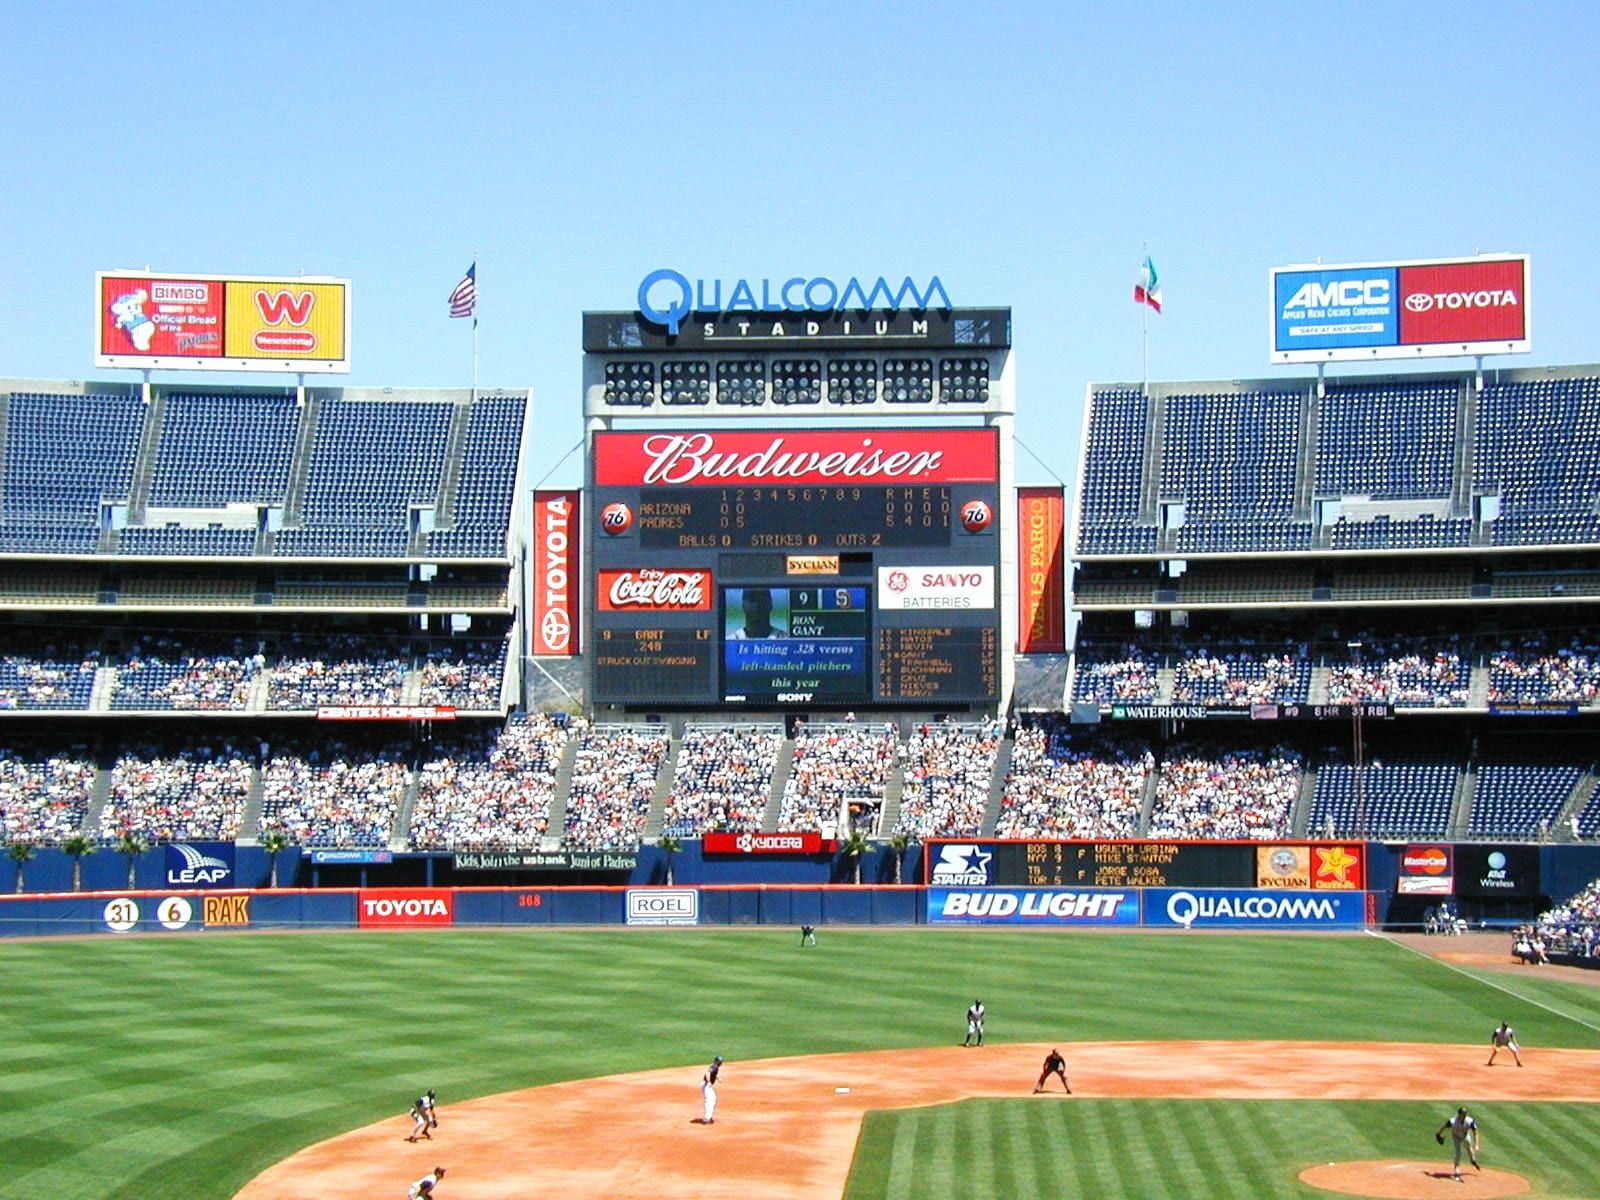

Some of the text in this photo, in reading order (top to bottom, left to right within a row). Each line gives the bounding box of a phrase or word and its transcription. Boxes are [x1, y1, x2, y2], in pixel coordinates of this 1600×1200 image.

[154, 287, 205, 300] BIMBO
[1284, 279, 1389, 309] AMCC
[1434, 289, 1517, 309] TOYOTA
[637, 268, 953, 335] QUALCOMM
[151, 313, 217, 325] Official Bread
[703, 319, 929, 337] STADIUM
[642, 432, 943, 485] Budweiser
[721, 490, 727, 501] 1
[736, 490, 745, 501] 2
[753, 490, 762, 501] 3
[770, 490, 778, 501] 4
[787, 490, 796, 501] 5
[803, 489, 812, 500] 6
[836, 489, 845, 500] 8
[852, 489, 861, 500] 9
[886, 488, 895, 499] R
[905, 488, 913, 499] H
[923, 488, 931, 499] E
[639, 501, 950, 515] ARIZONA 0 0 0 0 0 0
[605, 511, 625, 525] 76
[639, 517, 685, 529] PADRES
[720, 517, 729, 528] 0
[736, 517, 745, 528] 5
[886, 515, 895, 526] 5
[905, 515, 913, 526] 4
[923, 515, 931, 526] 0
[966, 509, 984, 523] 76
[679, 534, 881, 547] BALLS 0 STRIKES 0 OUTS 2
[1030, 501, 1045, 568] FARGO
[546, 495, 568, 606] TOYOTA
[789, 560, 837, 569] SYCUAN
[639, 569, 665, 580] Enjoy
[921, 573, 983, 587] SANYO
[799, 592, 809, 605] 9
[903, 597, 971, 608] BATTERIES
[792, 616, 816, 625] RON
[603, 629, 712, 640] 9 GANT LF
[792, 626, 824, 636] GANT
[634, 641, 662, 652] .248
[738, 644, 748, 655] Is
[753, 644, 788, 656] hitting
[819, 645, 854, 655] versus
[597, 656, 630, 666] STRUCK
[632, 656, 650, 666] OUT
[741, 661, 852, 673] left-handed pitchers
[771, 677, 820, 690] this year
[776, 693, 814, 702] SONY
[1126, 706, 1207, 719] WATERHOUSE
[1284, 707, 1299, 717] #9
[1314, 706, 1322, 717] 8
[1323, 706, 1340, 716] HR
[1367, 706, 1388, 717] RBI
[752, 837, 802, 849] KYOCERA
[1027, 844, 1048, 854] BOS
[1139, 844, 1179, 854] URBINA
[1027, 854, 1048, 863] NYY
[1095, 854, 1122, 863] MIKE
[1078, 849, 1085, 859] F
[480, 854, 502, 869] Join
[503, 854, 521, 866] the
[570, 855, 600, 869] Junior
[603, 854, 637, 868] Padres
[1404, 856, 1447, 866] MasterCard
[168, 869, 225, 884] LEAP
[1027, 866, 1041, 875] TB
[1095, 866, 1128, 875] JORGE
[1078, 870, 1085, 880] F
[1487, 870, 1507, 879] AT&T
[932, 873, 987, 885] STARTER
[1027, 875, 1167, 886] TOR 5 PETE WALKER
[1260, 877, 1308, 888] SYCUAN
[1480, 878, 1515, 889] Wireless
[519, 894, 541, 906] 368
[637, 897, 687, 911] ROEL
[942, 893, 1124, 917] BUD LIGHT
[111, 904, 132, 923] 31
[167, 903, 182, 921] 6
[204, 896, 249, 925] RAK
[363, 899, 448, 916] TOYOTA
[1166, 892, 1335, 929] QUALCOMM
